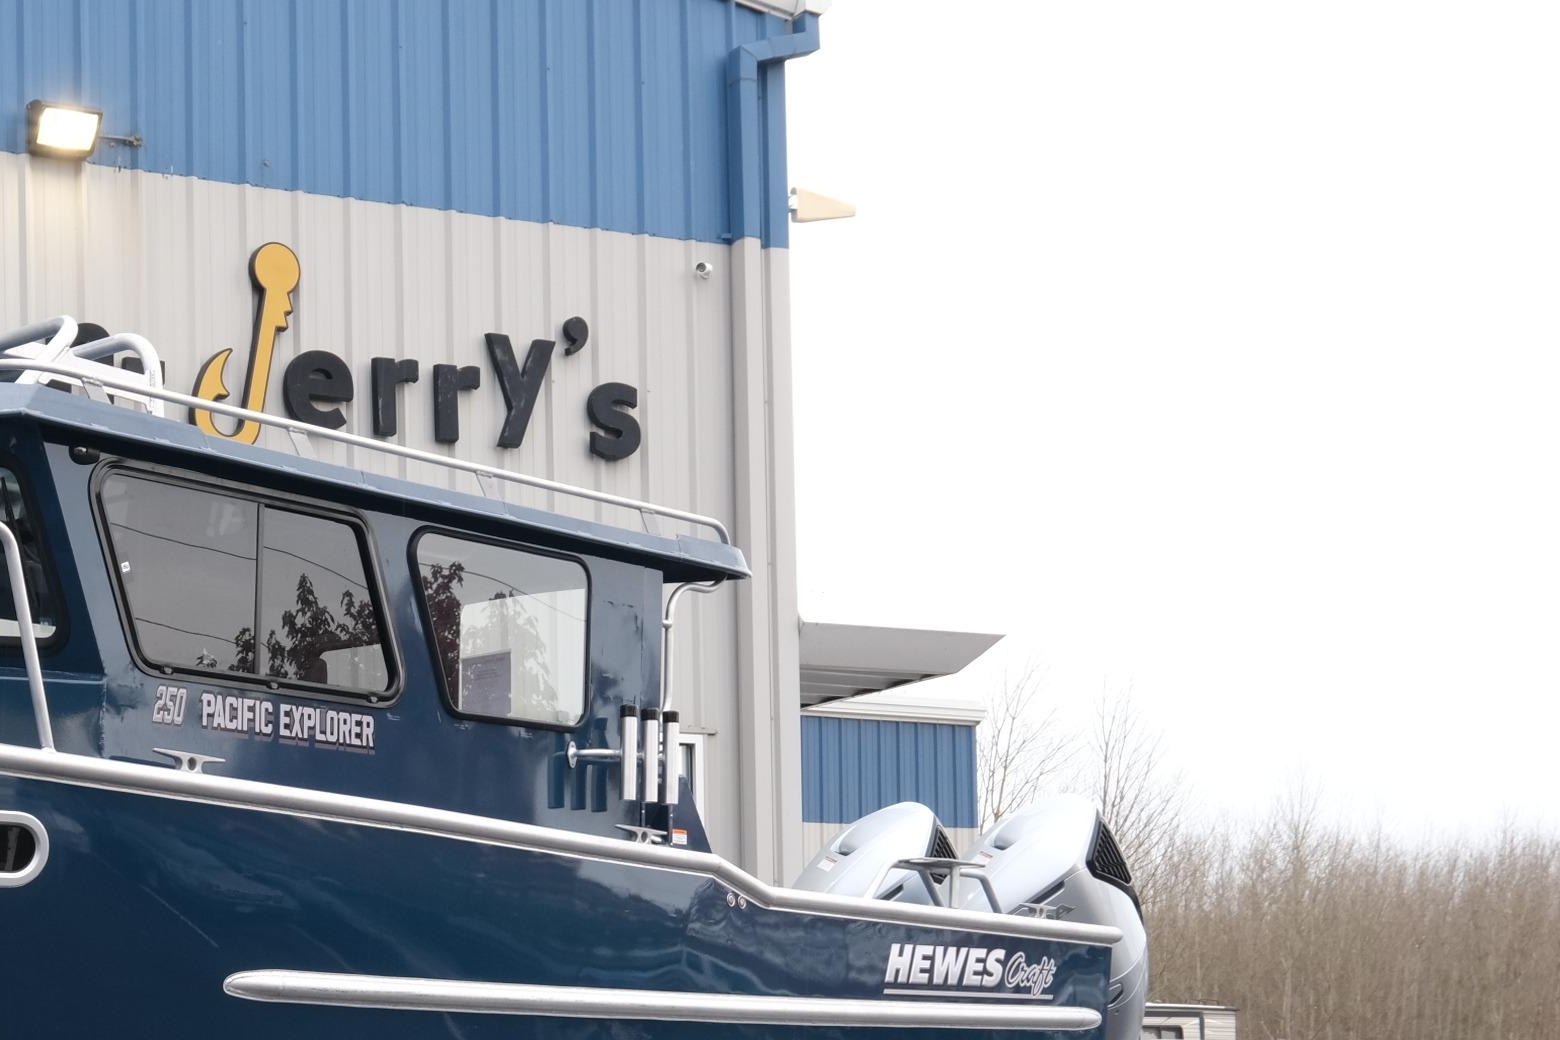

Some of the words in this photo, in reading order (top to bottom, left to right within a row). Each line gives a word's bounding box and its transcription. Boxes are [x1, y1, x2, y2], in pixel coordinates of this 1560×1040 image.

[152, 685, 187, 725] 250
[201, 693, 273, 736] PACIFIC
[279, 703, 376, 748] EXPLORER
[884, 943, 1006, 988] HEWES
